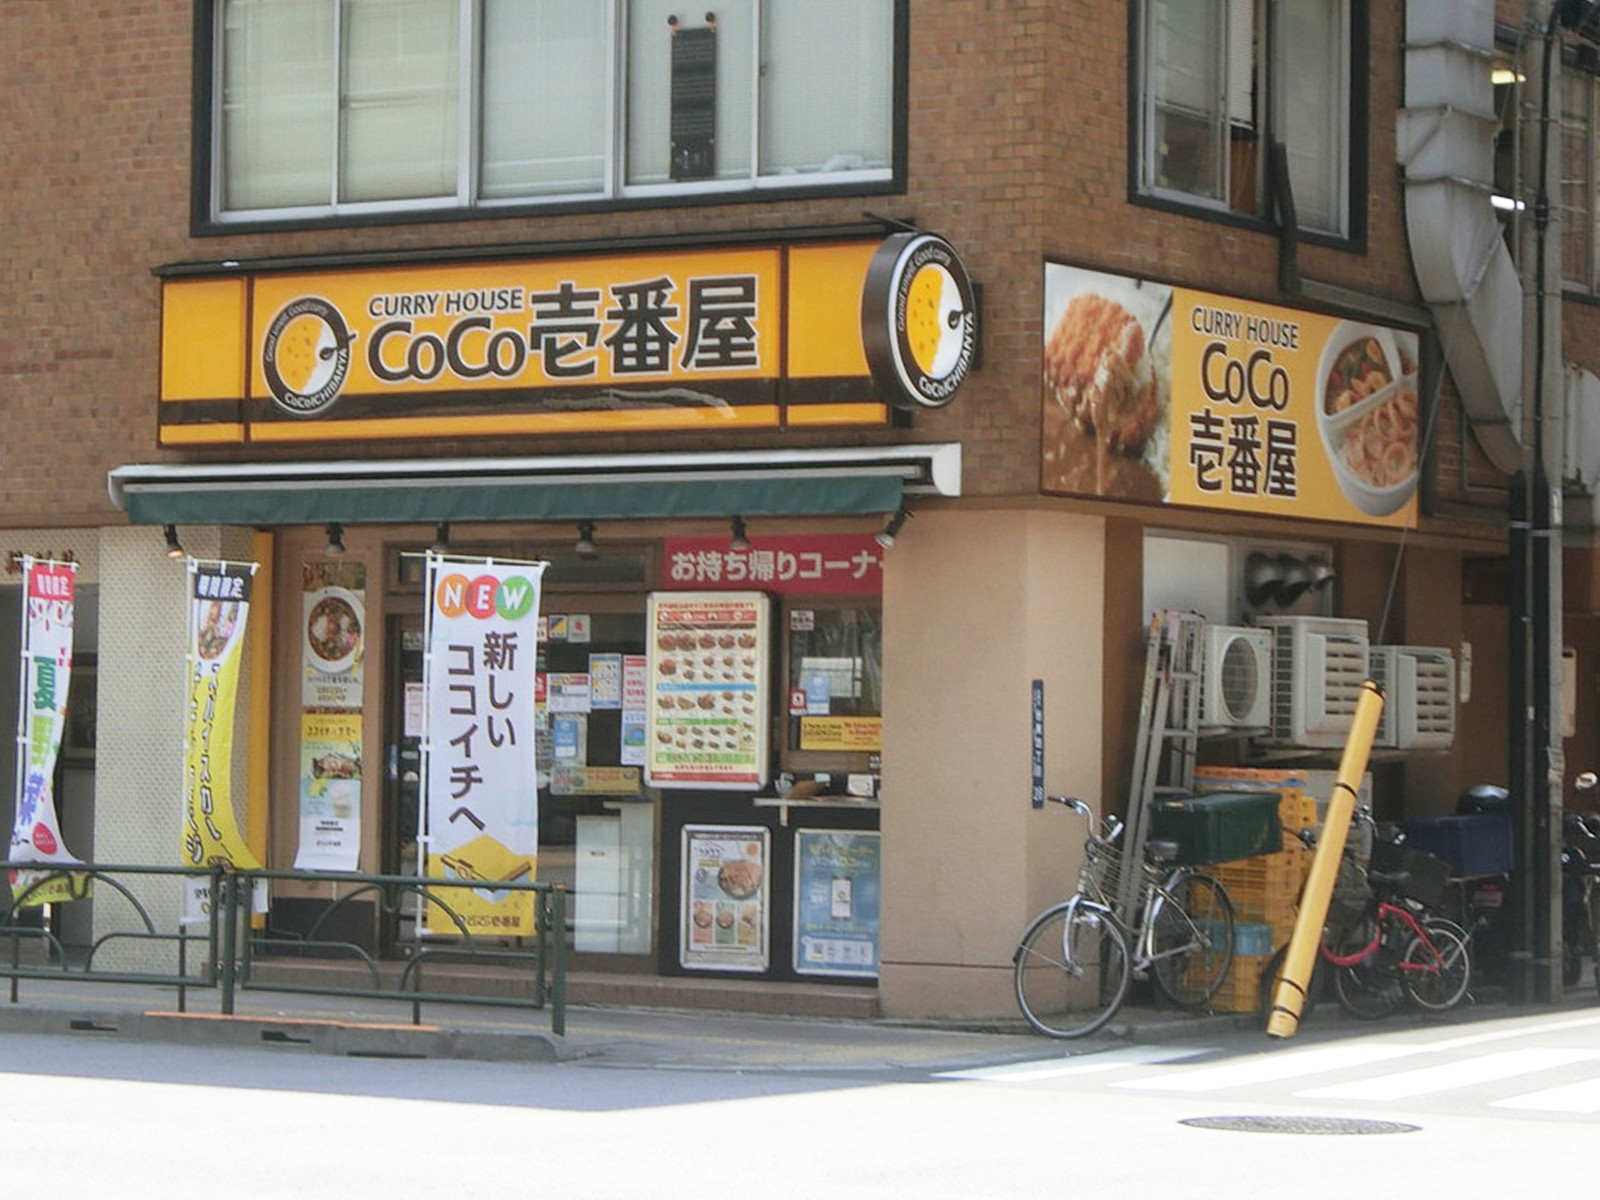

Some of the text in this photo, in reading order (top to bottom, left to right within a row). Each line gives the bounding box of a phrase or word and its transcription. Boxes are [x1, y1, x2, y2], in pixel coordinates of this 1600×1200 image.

[369, 289, 523, 316] CURRY HOUSE
[1192, 307, 1298, 349] CURRY HOUSE
[1202, 342, 1290, 411] CoCo
[1190, 408, 1296, 497] 壱番屋
[671, 550, 883, 582] お持ち帰りコーナ
[444, 582, 528, 611] NEW
[483, 631, 518, 748] 新しい
[448, 644, 486, 831] ココイチへ
